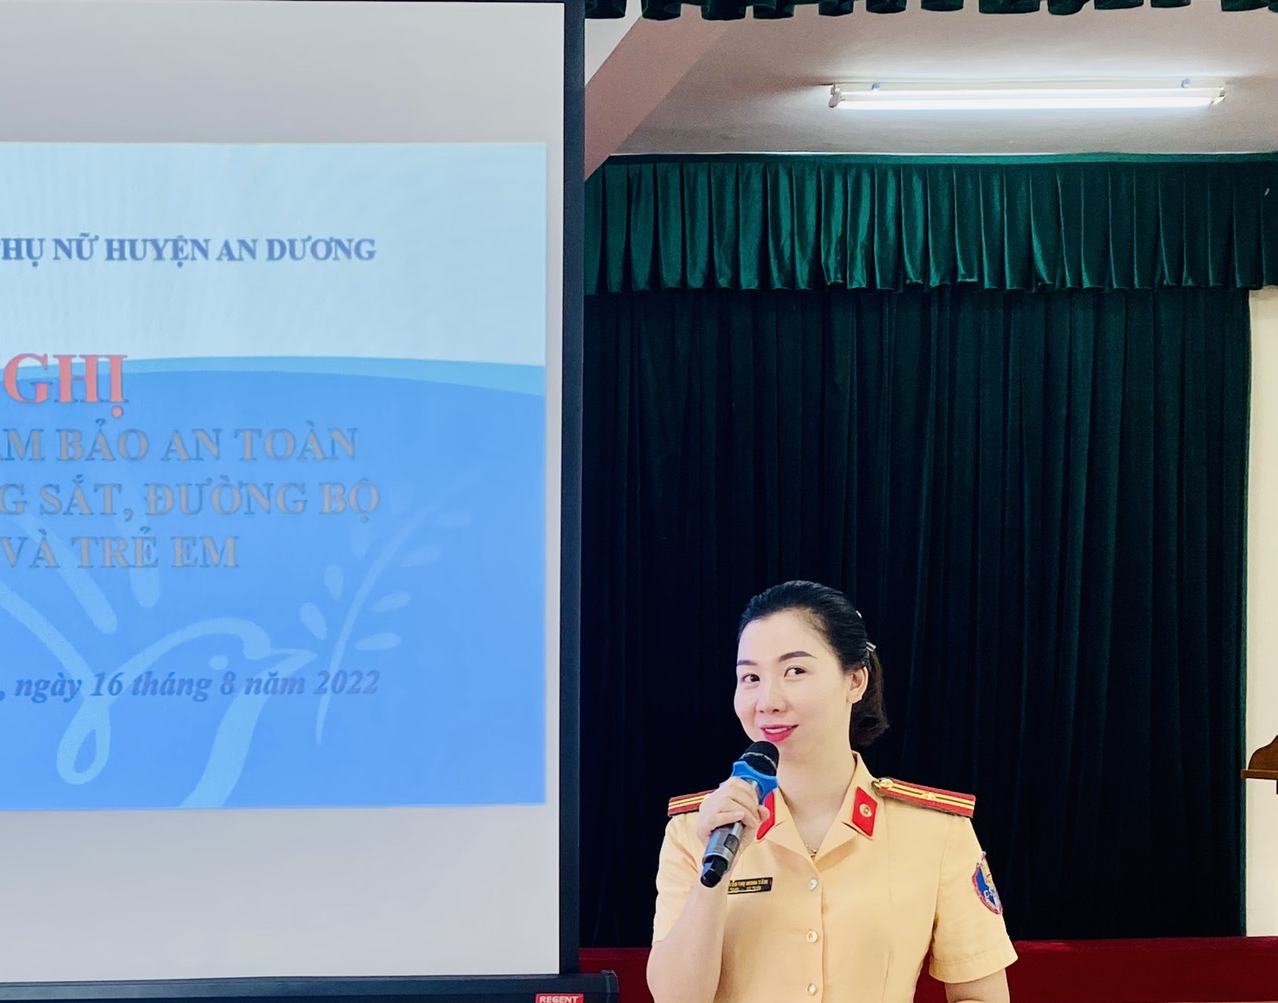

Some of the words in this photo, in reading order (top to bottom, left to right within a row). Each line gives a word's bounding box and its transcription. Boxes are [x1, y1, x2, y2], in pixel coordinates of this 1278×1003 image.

[52, 232, 99, 261] NỮ
[105, 235, 211, 268] HUYỆN
[216, 238, 258, 261] AN
[266, 235, 377, 262] DƯƠNG
[56, 418, 149, 462] BẢO
[161, 428, 223, 462] AN
[234, 420, 359, 462] TOÀN
[39, 474, 134, 522] SẮT,
[143, 475, 308, 515] ĐƯỜNG
[318, 478, 380, 524] BỘ
[71, 526, 159, 569] TRẺ
[170, 536, 240, 569] EM
[14, 672, 83, 703] ngày
[90, 671, 124, 696] 16
[131, 671, 213, 702] tháng
[219, 671, 237, 696] 8
[244, 672, 305, 695] năm
[313, 670, 381, 695] 2022
[539, 996, 578, 1003] REGENT
